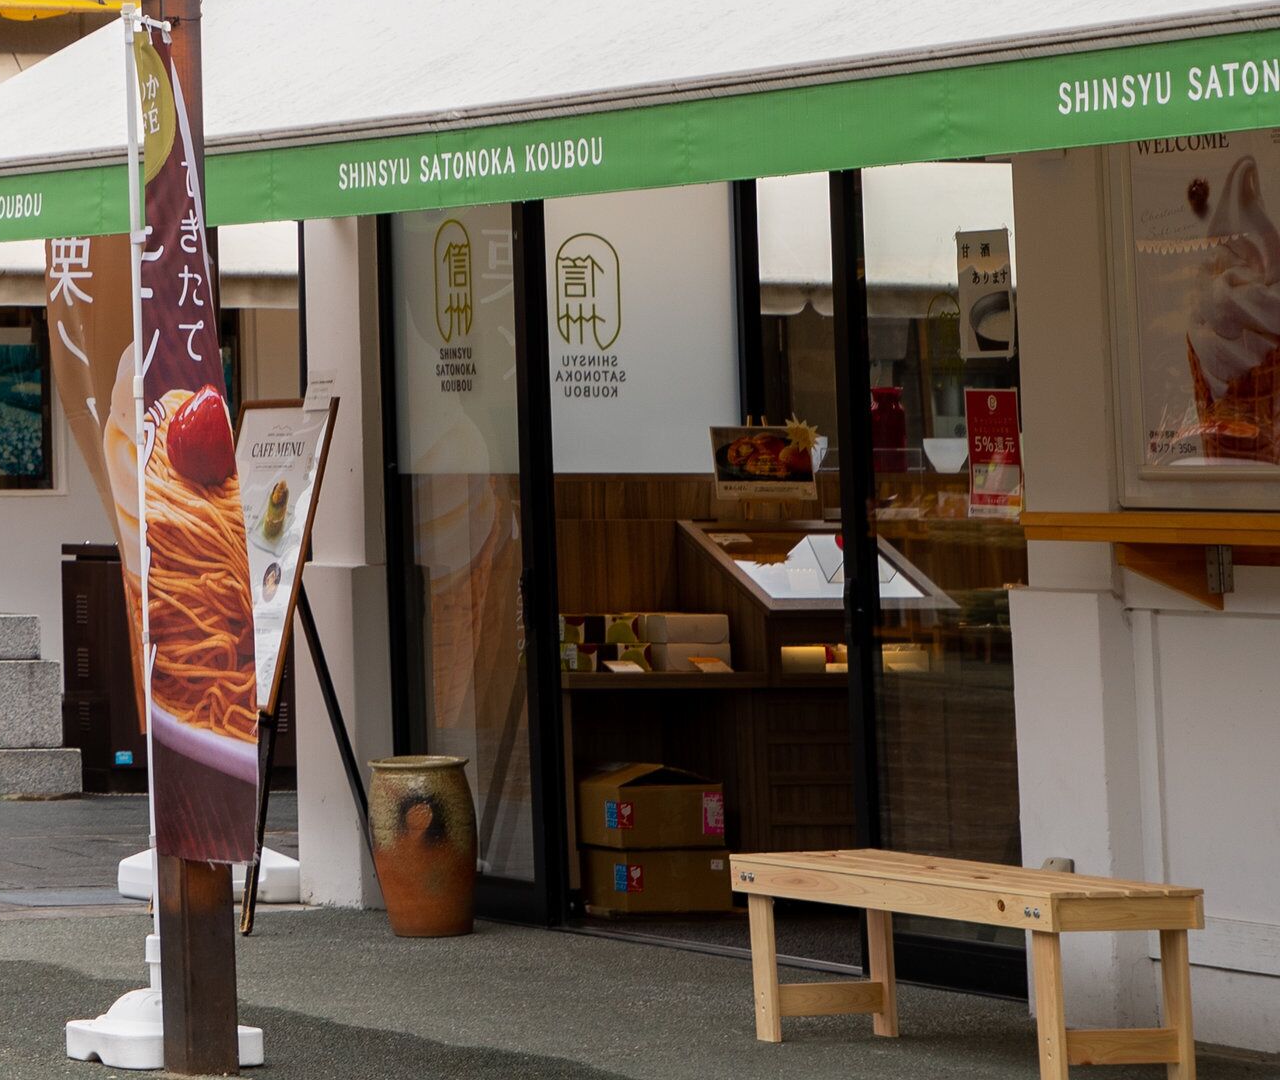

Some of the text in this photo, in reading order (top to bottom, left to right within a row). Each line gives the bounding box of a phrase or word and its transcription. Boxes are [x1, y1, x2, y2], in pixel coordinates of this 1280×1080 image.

[1058, 58, 1280, 115] SHINSYU SATON
[1136, 133, 1230, 155] WELCOME
[339, 136, 604, 190] SHINSYU SATONOKA KOUBOU
[961, 243, 991, 259] 甘酒
[972, 270, 1009, 285] あります
[440, 347, 472, 359] SHINSYU
[436, 363, 476, 376] SATONOKA
[441, 379, 472, 392] KOUBOU
[251, 441, 305, 458] CAFE MENU
[975, 435, 1015, 453] 5%還元
